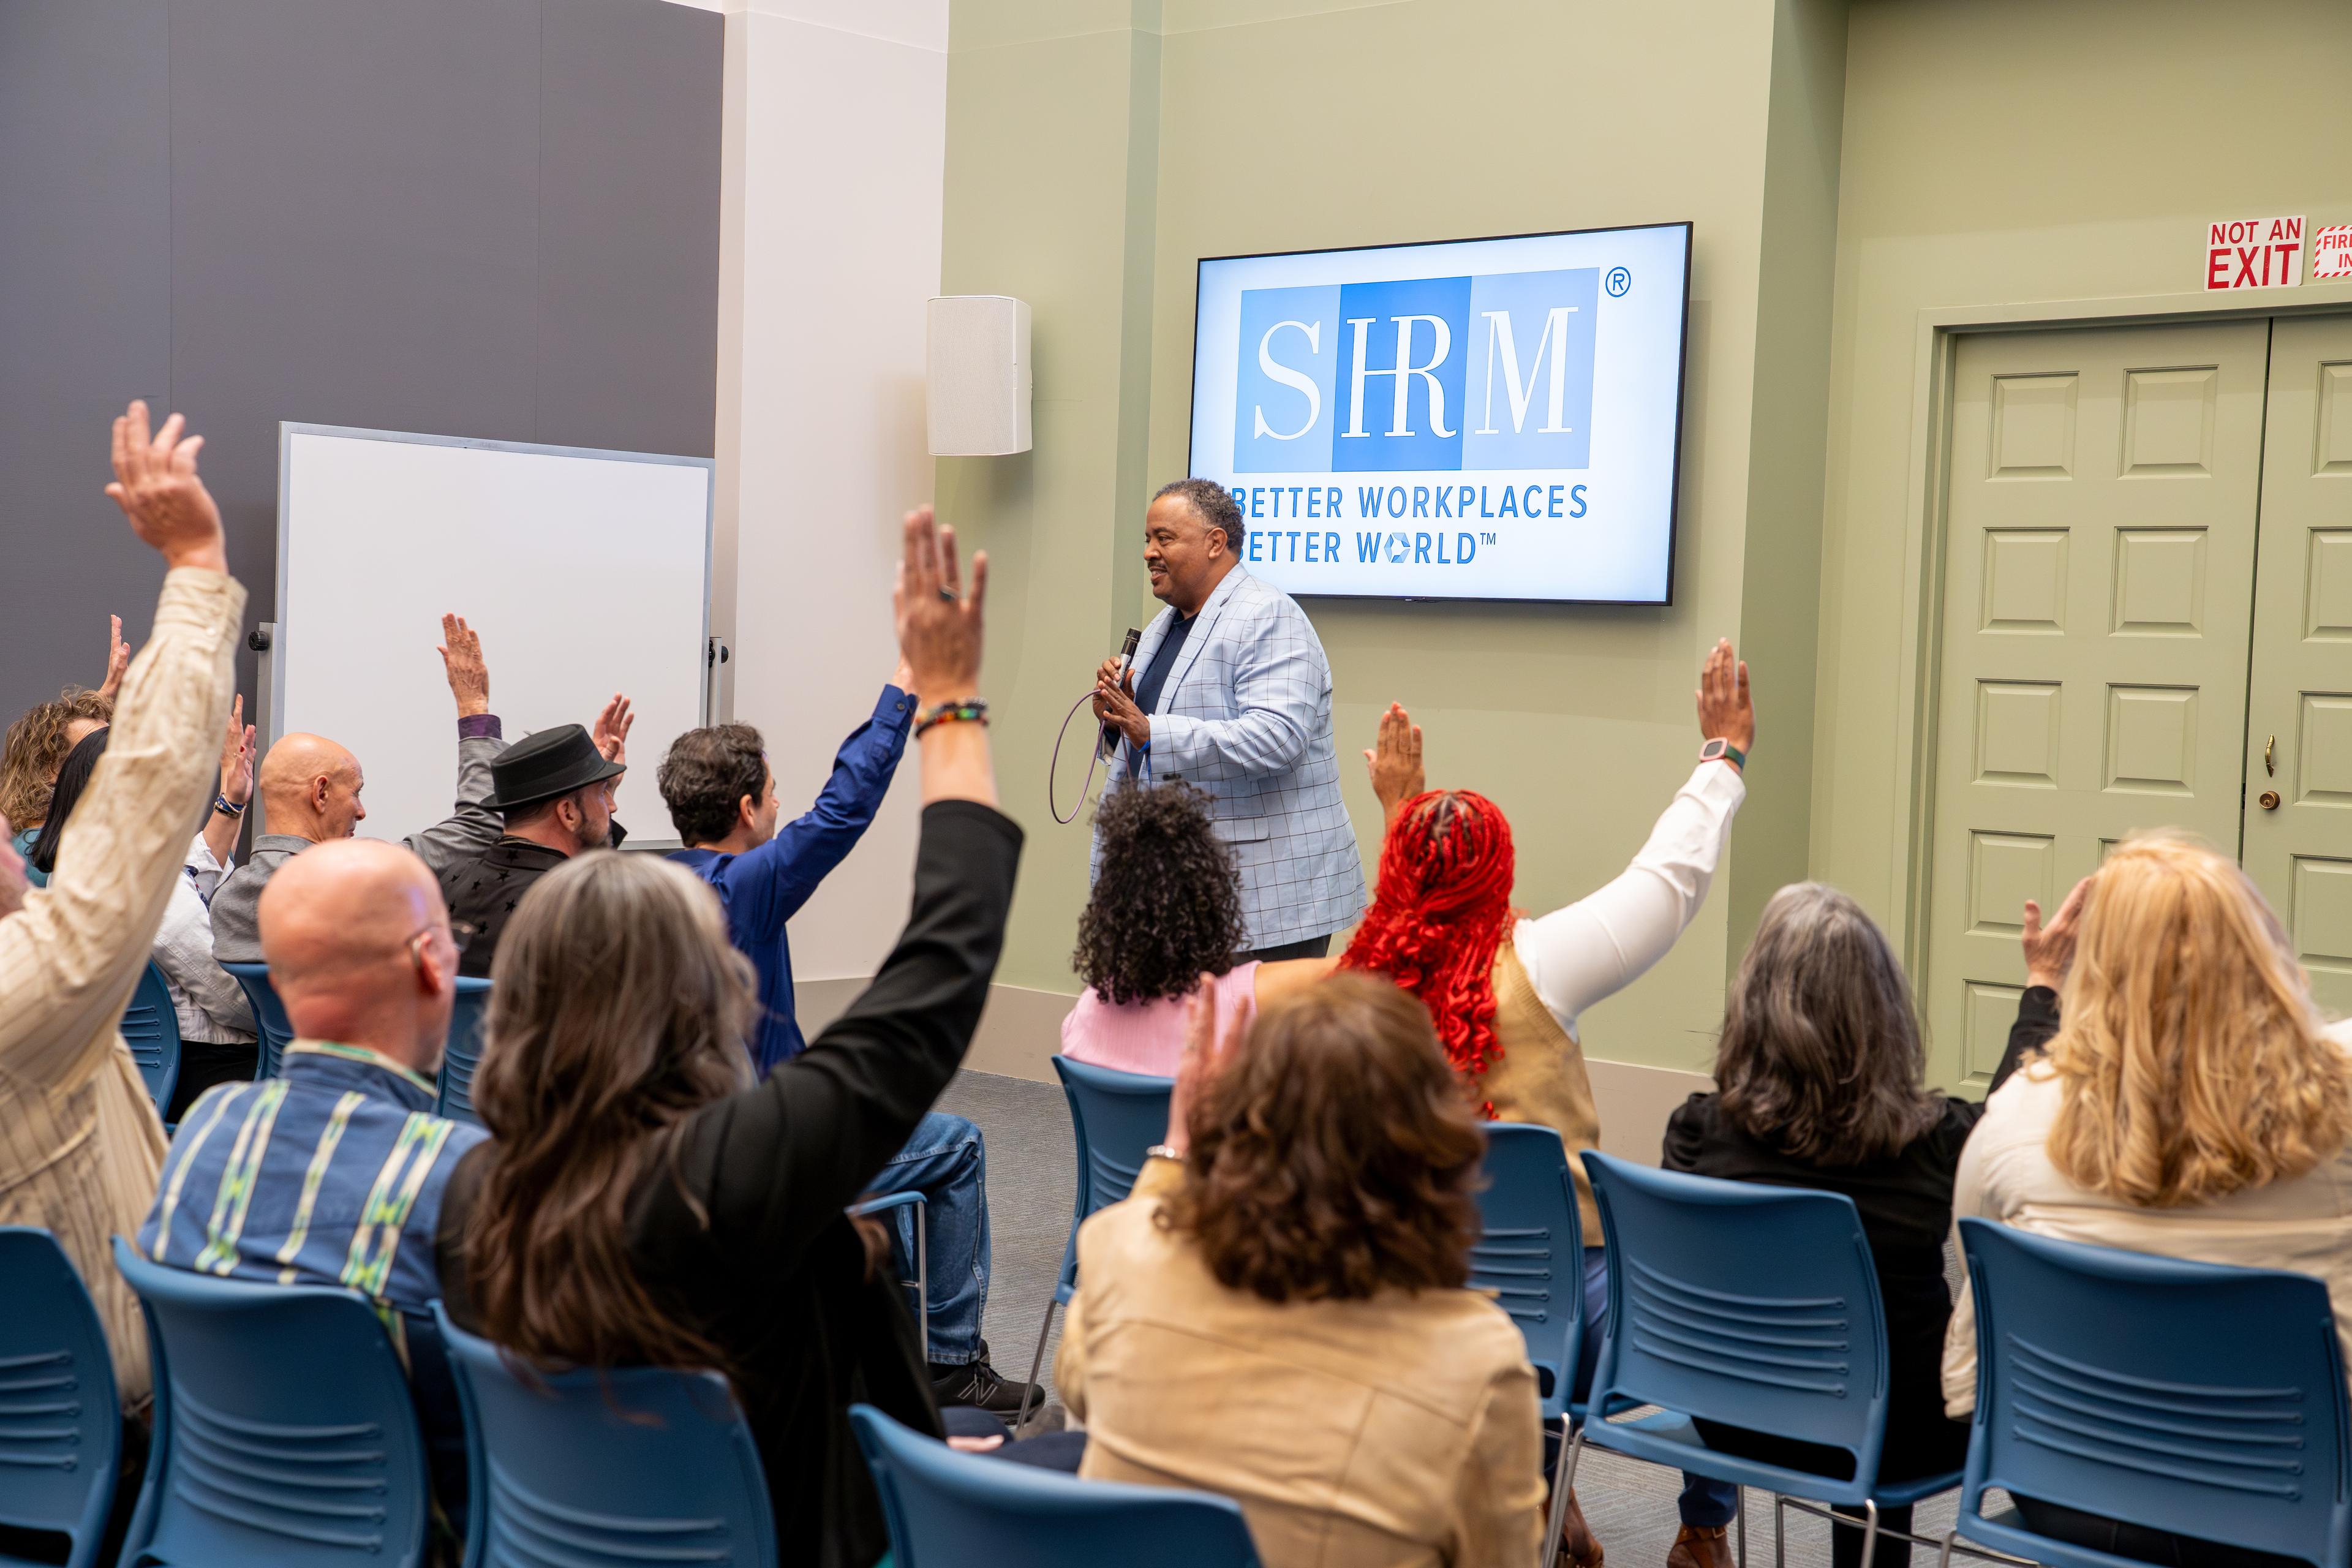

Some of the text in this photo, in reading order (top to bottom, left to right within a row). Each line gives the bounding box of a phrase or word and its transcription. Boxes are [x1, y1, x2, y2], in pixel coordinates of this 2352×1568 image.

[2211, 217, 2302, 245] NOT AN
[2207, 243, 2300, 290] EXIT
[1254, 306, 1580, 440] SHRM
[1231, 484, 1588, 518] BETTER WORKPLACES
[1239, 531, 1341, 562] ETTER
